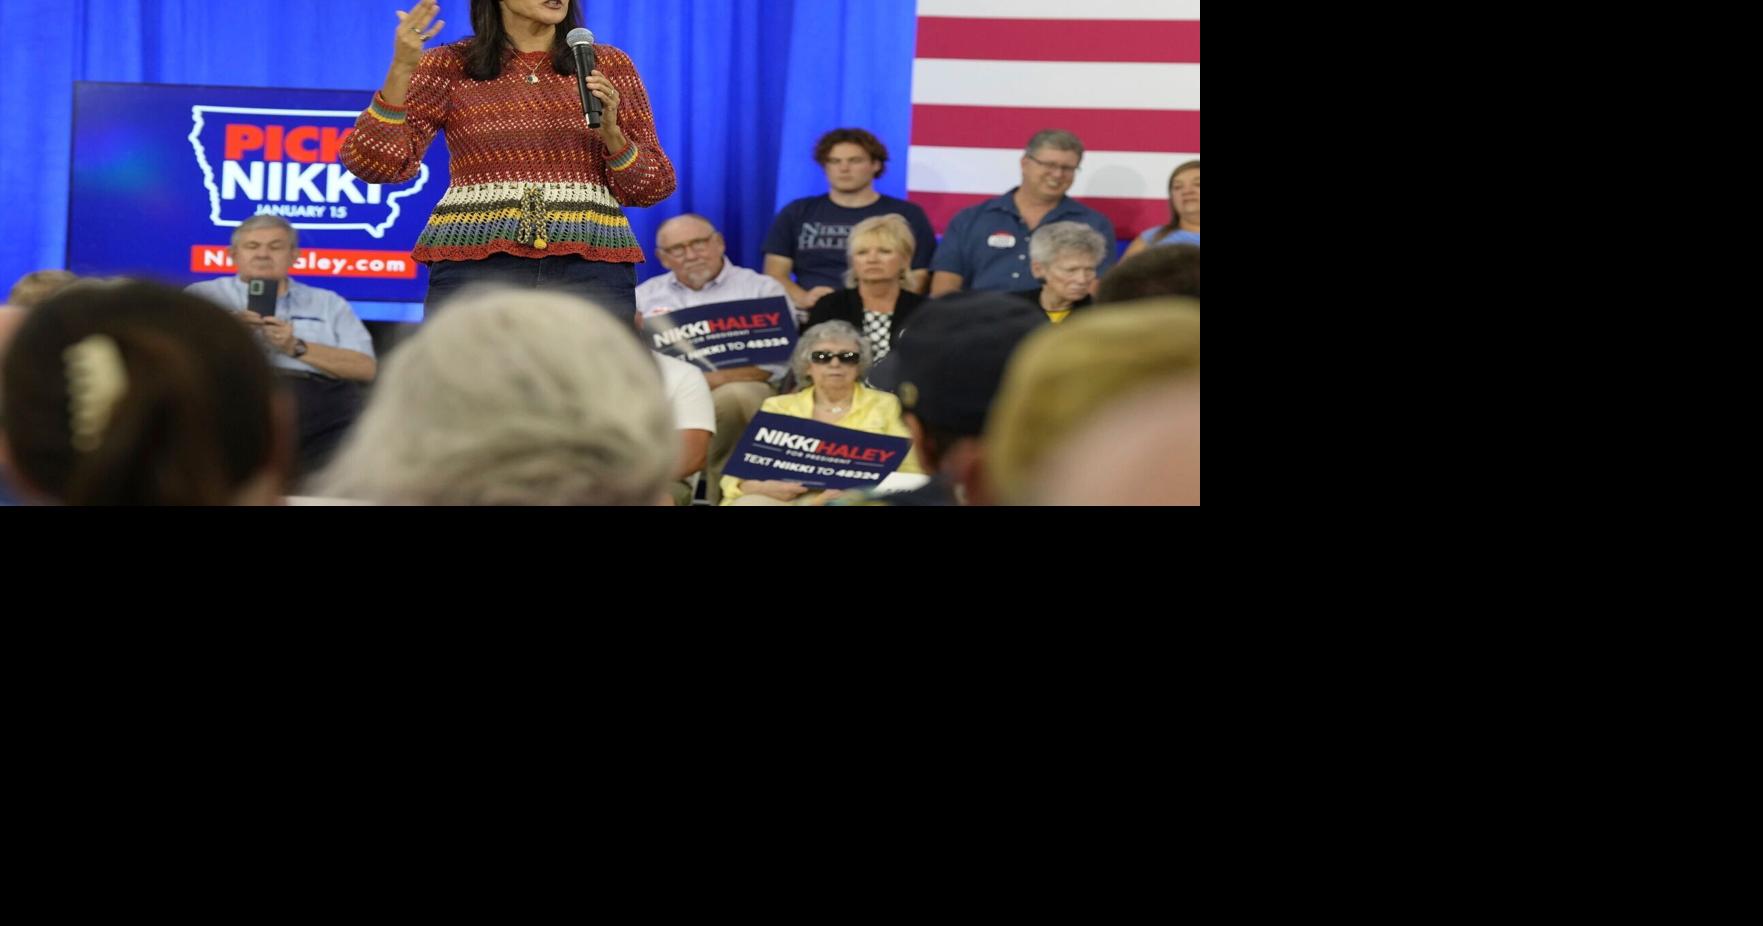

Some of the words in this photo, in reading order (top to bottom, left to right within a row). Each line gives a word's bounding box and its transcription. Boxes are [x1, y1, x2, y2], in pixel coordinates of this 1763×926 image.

[254, 204, 325, 218] JANUARY
[329, 205, 348, 219] 15
[727, 341, 746, 351] TO
[744, 453, 771, 467] TEXT
[773, 459, 816, 474] NIKKI
[817, 466, 834, 476] TO
[785, 450, 803, 458] FOR
[805, 453, 852, 465] PRESIDENT
